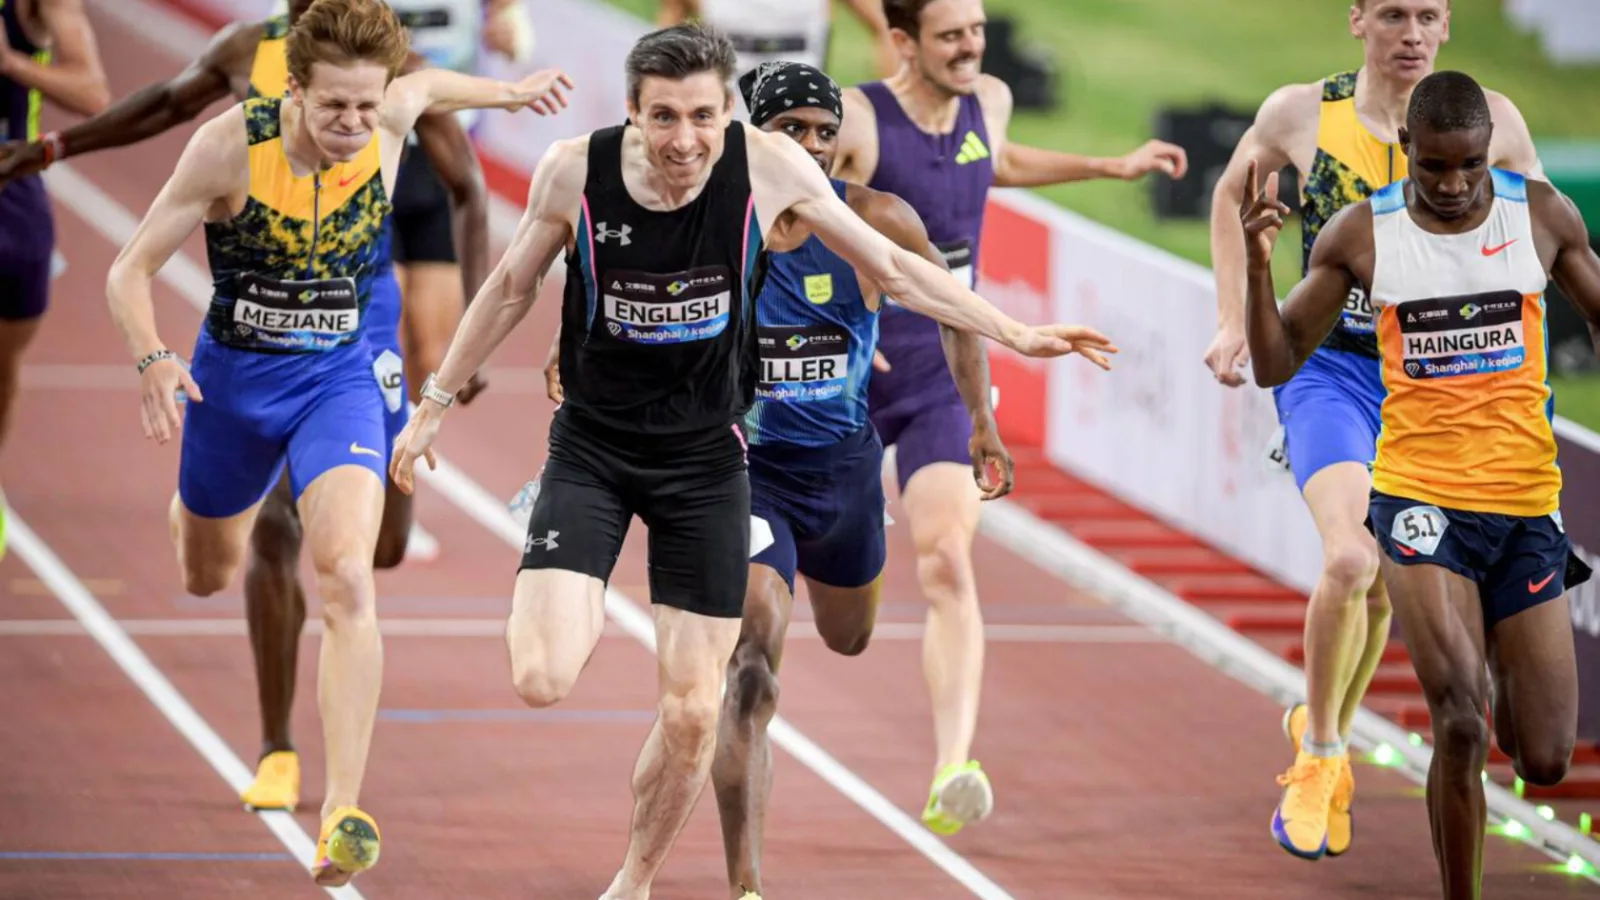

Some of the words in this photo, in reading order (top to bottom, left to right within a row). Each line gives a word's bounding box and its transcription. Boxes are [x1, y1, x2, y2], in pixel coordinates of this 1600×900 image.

[243, 305, 349, 331] MEZIANE
[615, 298, 719, 323] ENGLISH
[626, 328, 681, 341] Shanghai
[1408, 327, 1517, 355] HAINGURA
[760, 358, 836, 382] ILLER
[1425, 360, 1478, 375] Shanghai
[755, 386, 798, 400] hanghai
[1402, 513, 1438, 541] 5.1
